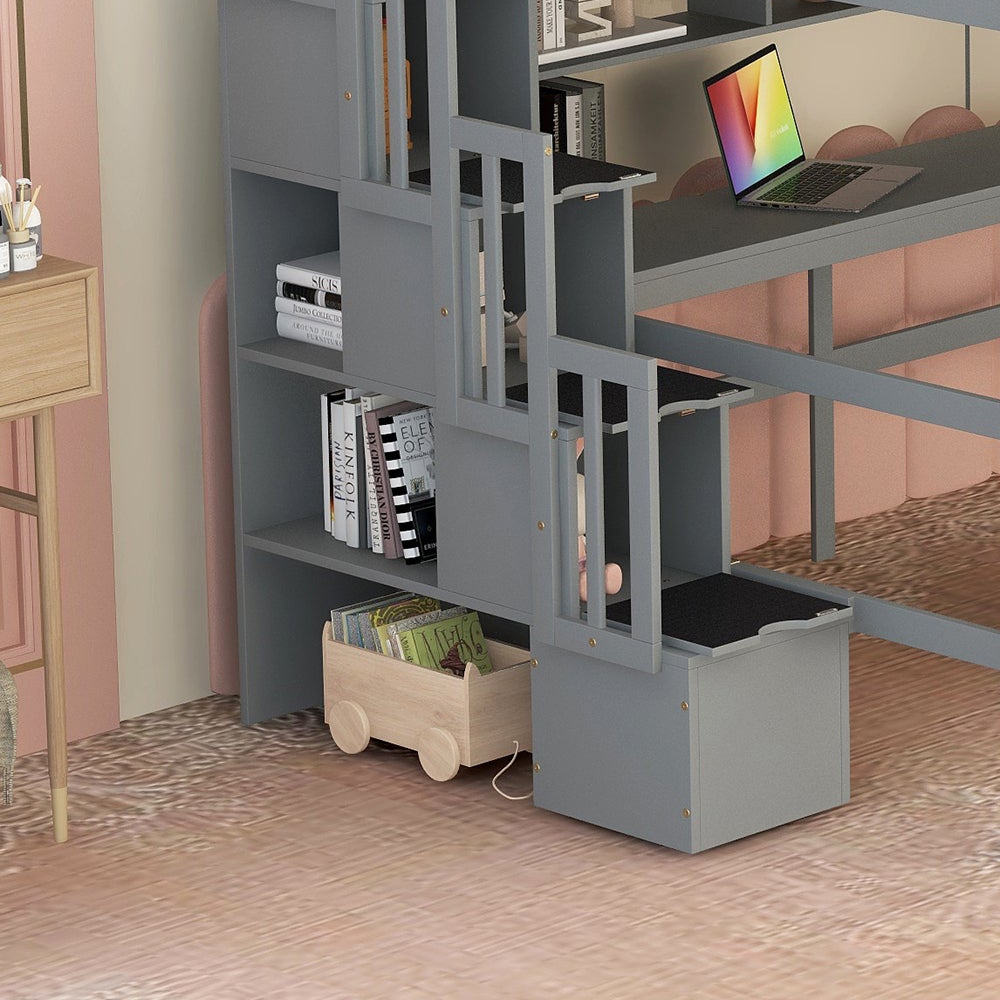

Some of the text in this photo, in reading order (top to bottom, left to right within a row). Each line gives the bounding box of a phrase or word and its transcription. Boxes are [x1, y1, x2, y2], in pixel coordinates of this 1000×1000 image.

[312, 275, 338, 292] SICIS
[292, 322, 319, 334] AROUND
[322, 328, 334, 338] THE
[367, 431, 377, 448] BY
[404, 438, 424, 453] OF
[344, 431, 356, 520] KINFOLK
[370, 449, 386, 510] CHRISTIAN
[380, 511, 391, 540] DIOR
